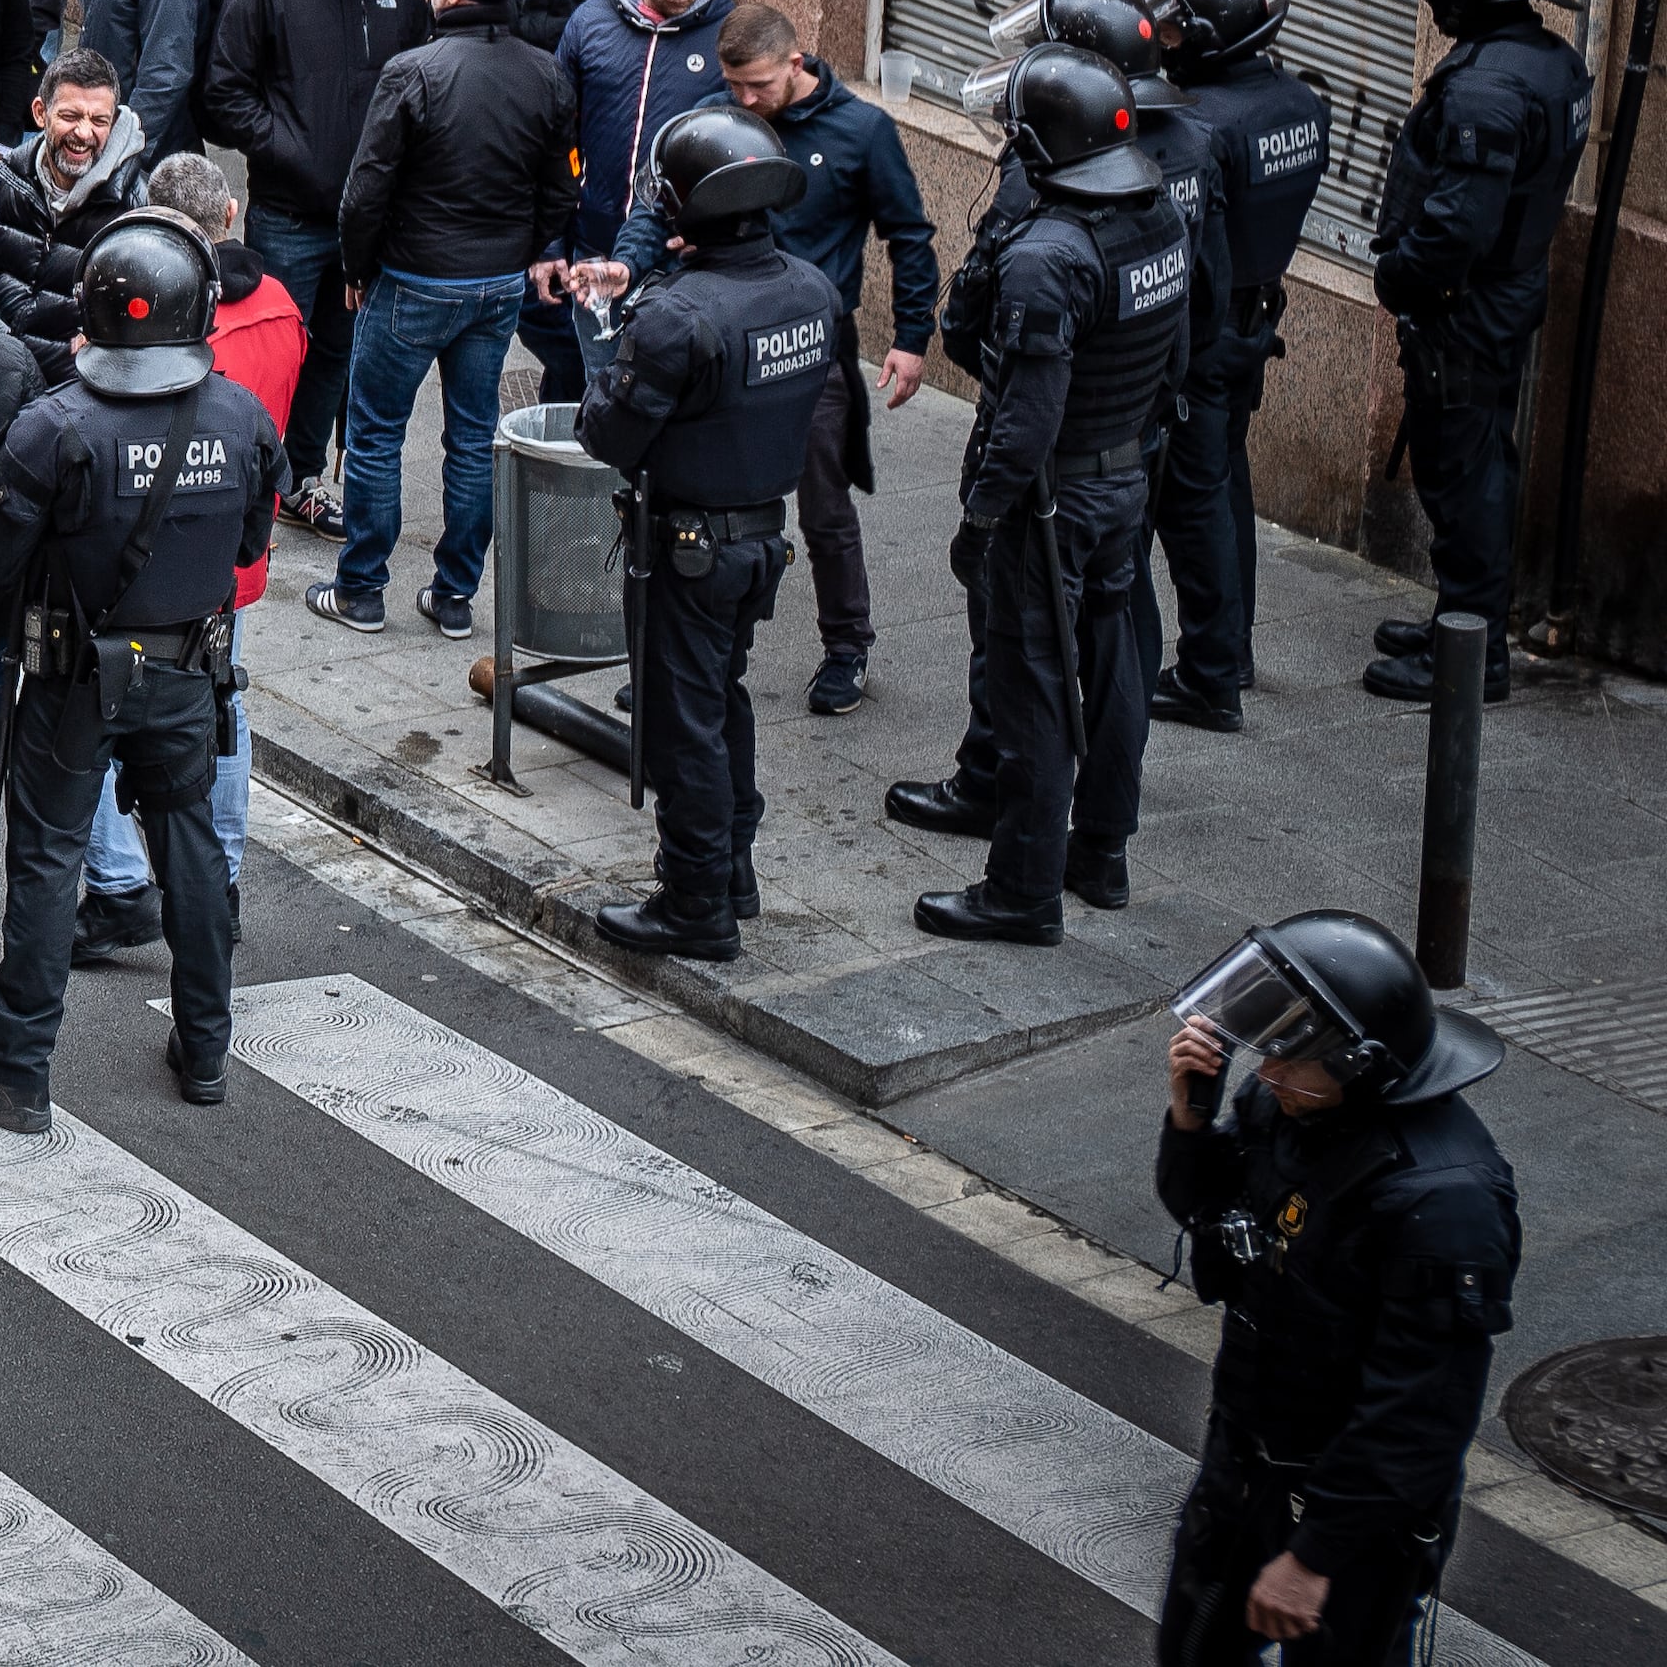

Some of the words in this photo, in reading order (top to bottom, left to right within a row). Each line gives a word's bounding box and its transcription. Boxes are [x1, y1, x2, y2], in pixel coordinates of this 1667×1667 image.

[1258, 120, 1319, 160] POLICIA
[1169, 176, 1199, 203] ICIA
[1129, 248, 1186, 294] POLICIA
[756, 319, 826, 361] POLICIA
[760, 347, 823, 379] D300A3378
[127, 439, 227, 469] POCIA
[133, 469, 222, 489] D0A4195
